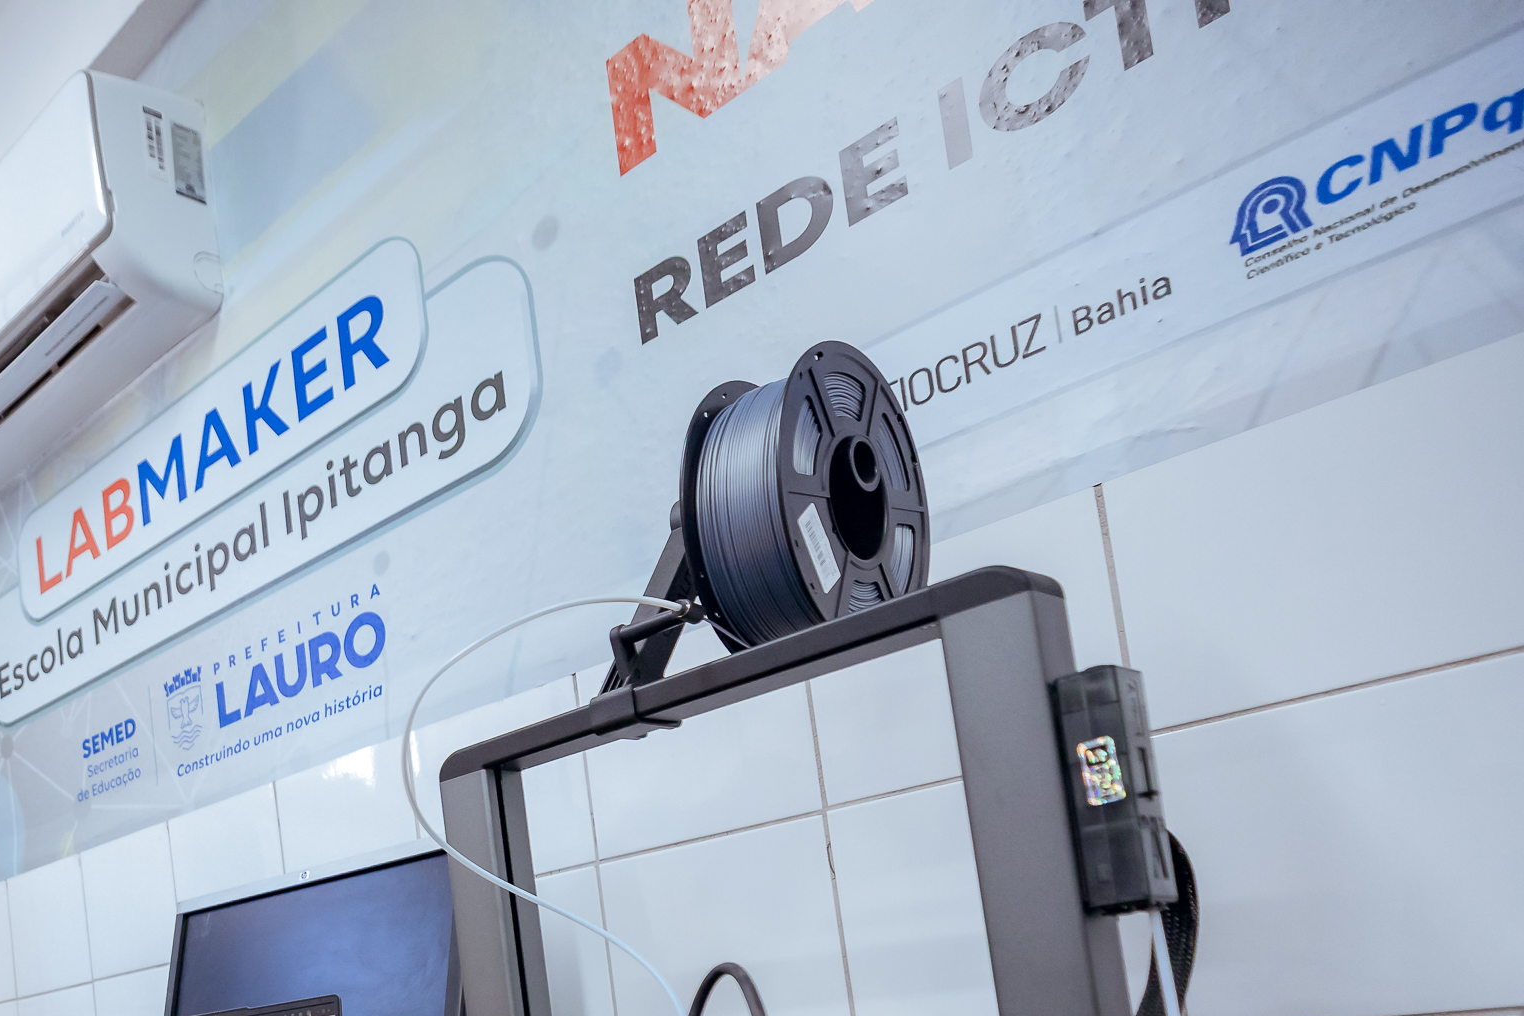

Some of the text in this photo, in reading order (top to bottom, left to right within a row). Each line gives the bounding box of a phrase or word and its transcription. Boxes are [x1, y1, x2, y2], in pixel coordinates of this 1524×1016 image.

[1316, 87, 1524, 205] CNPq
[633, 115, 910, 346] REDE
[1244, 235, 1309, 268] Conselho
[1312, 203, 1376, 237] Nacional
[1379, 195, 1398, 209] de
[1314, 242, 1324, 251] e
[1328, 201, 1417, 244] Tecnológico
[888, 275, 1173, 412] IOCRUZ Bahia
[35, 294, 390, 596] LABMAKER
[92, 500, 270, 646] Municipal
[282, 369, 507, 541] Ipitanga
[213, 583, 381, 676] PREFEITURA
[215, 610, 386, 729] LAURO
[82, 717, 137, 759] SEMED
[87, 746, 139, 778] Secretaria
[177, 684, 383, 778] Construindo uma nova história
[77, 767, 142, 803] de Educação
